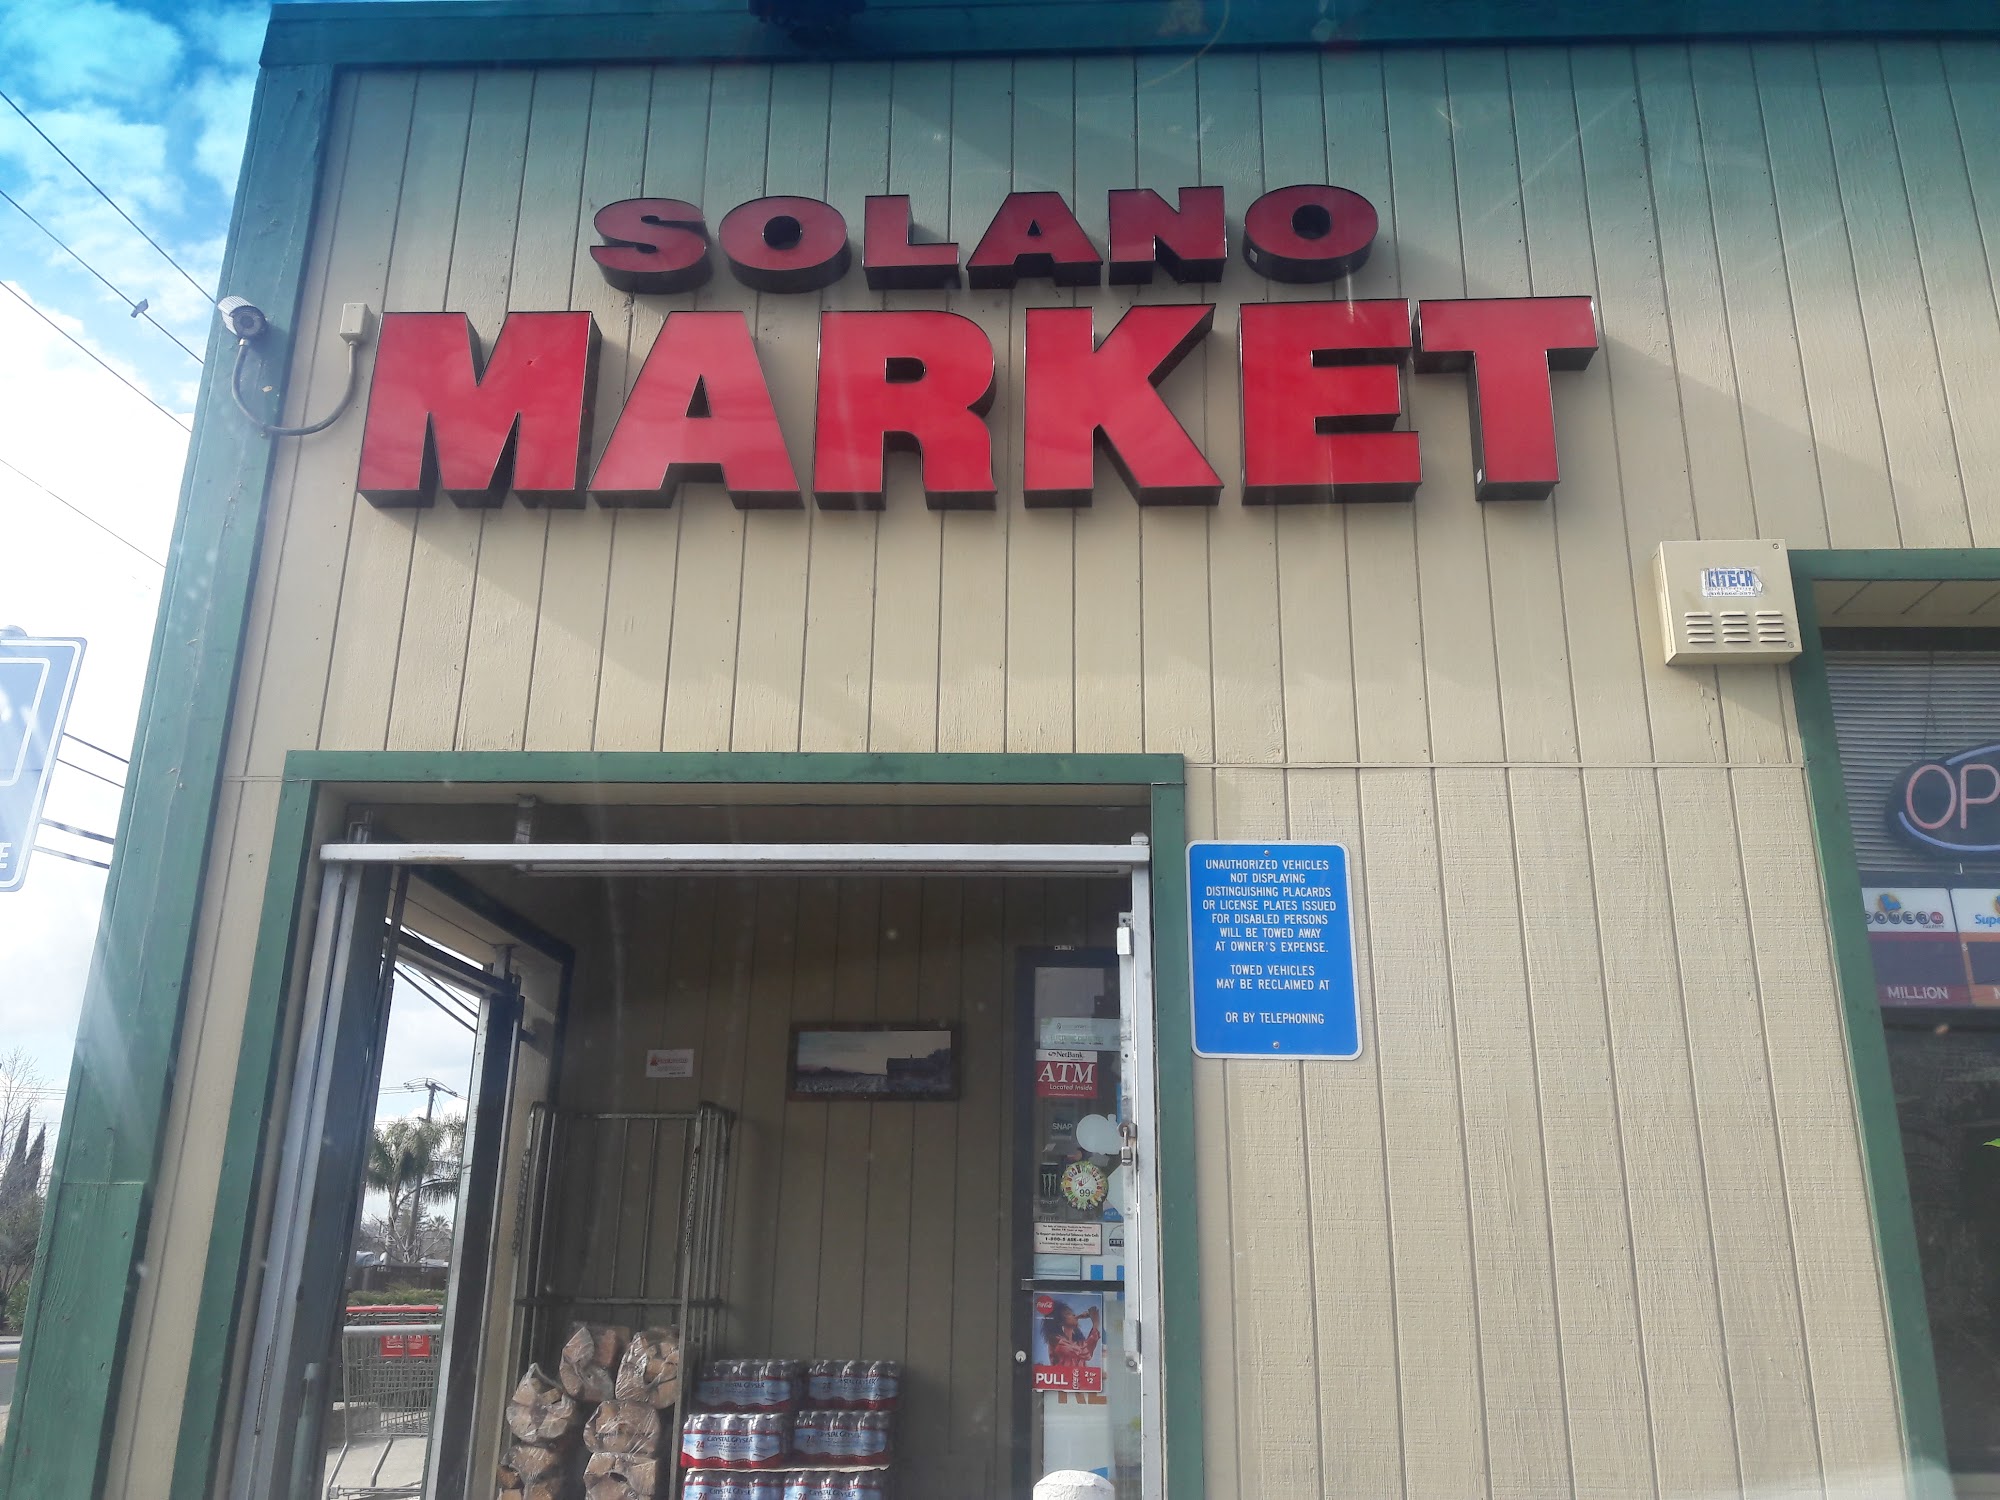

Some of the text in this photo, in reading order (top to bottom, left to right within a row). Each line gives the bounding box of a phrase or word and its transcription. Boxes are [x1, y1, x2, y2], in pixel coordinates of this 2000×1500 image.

[590, 184, 1379, 288] SOLANO
[357, 296, 1600, 506] MARKET
[1708, 570, 1754, 587] KITECH
[1205, 859, 1329, 871] UNAUTHORIZED VEHICLES
[1230, 873, 1306, 884] NOT DISPLAYING
[1206, 887, 1331, 898] DISTINGUISHING PLACARDS
[1202, 900, 1337, 911] OR LICENSE PLATES ISSUED
[1211, 914, 1328, 925] FOR DISABLED PERSONS
[1219, 928, 1321, 939] WILL BE TOWED AWAY
[1215, 941, 1329, 953] AT OWNER'S EXPENSE.
[1230, 965, 1315, 976] TOWED VEHICLES
[1216, 979, 1330, 991] MAY BE RECLAIMED AT
[1888, 986, 1948, 999] MILLION
[1225, 1013, 1325, 1024] OR BY TELEPHONING
[1038, 1062, 1095, 1083] ATM
[1036, 1373, 1068, 1385] PULL
